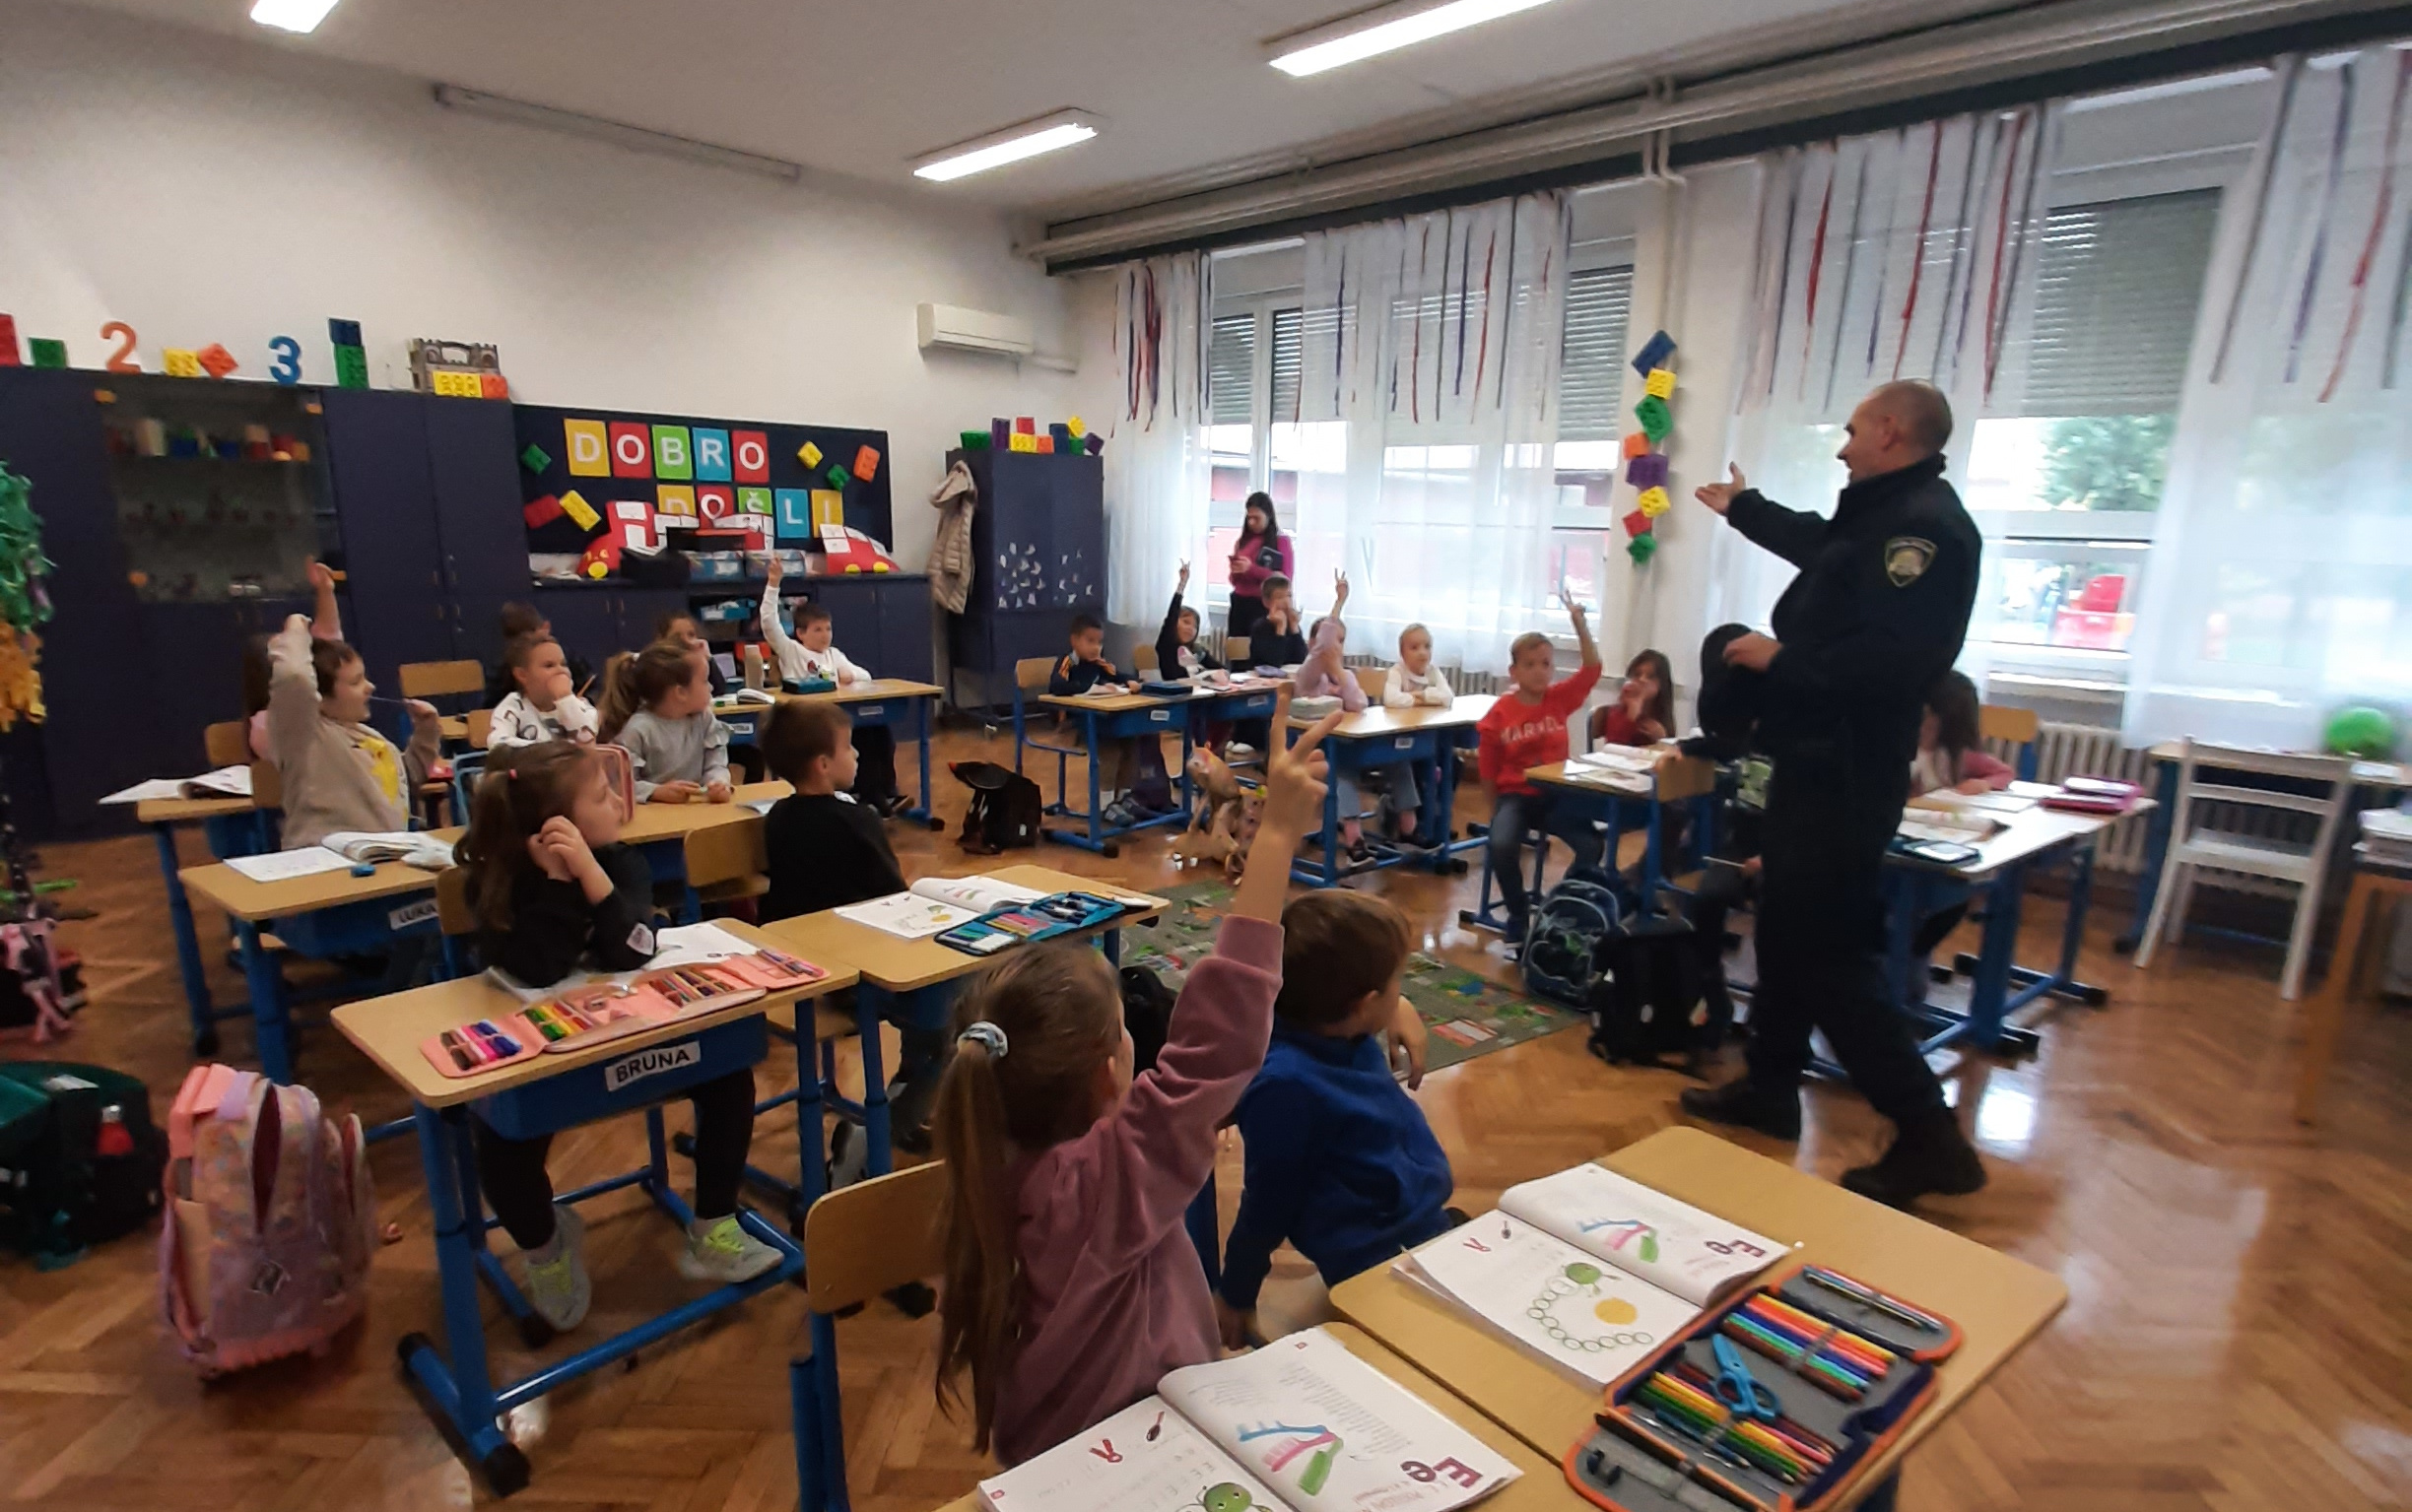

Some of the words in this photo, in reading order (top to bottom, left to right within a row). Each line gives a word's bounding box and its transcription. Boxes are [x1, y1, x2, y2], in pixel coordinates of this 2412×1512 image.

[100, 321, 141, 374] 2
[268, 335, 302, 385] 3
[574, 433, 765, 471] DOBRO
[616, 1049, 690, 1083] BRUNA
[1399, 1456, 1483, 1488] Ee
